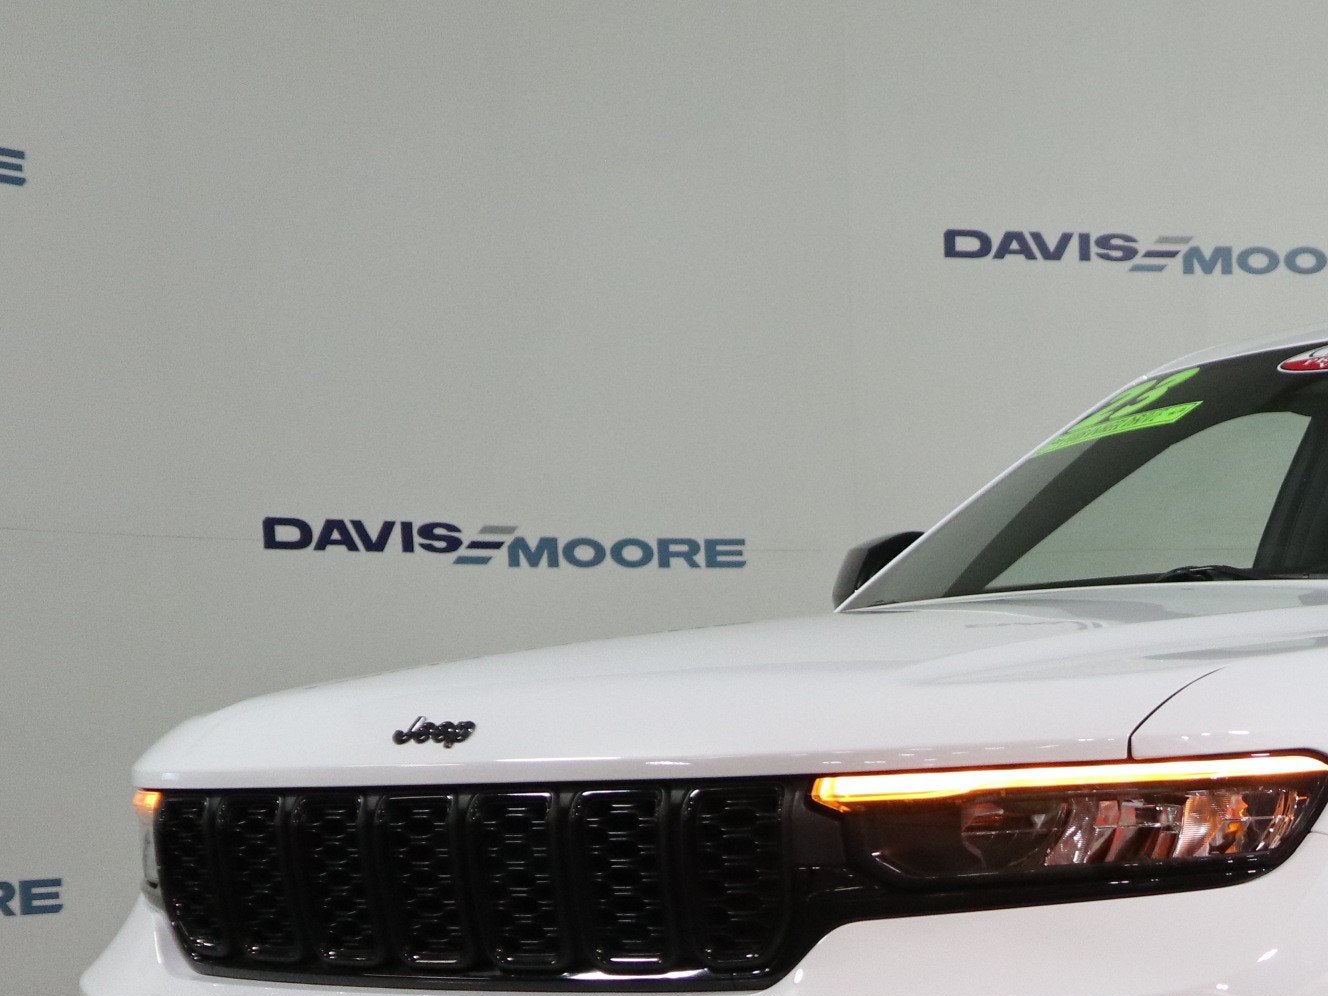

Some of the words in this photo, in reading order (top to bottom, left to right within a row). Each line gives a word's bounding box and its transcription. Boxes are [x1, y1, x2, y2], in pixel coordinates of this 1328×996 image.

[943, 228, 1138, 262] DAVIS
[262, 516, 463, 553] DAVIS
[508, 536, 747, 569] MOORE
[392, 715, 476, 749] Jeep
